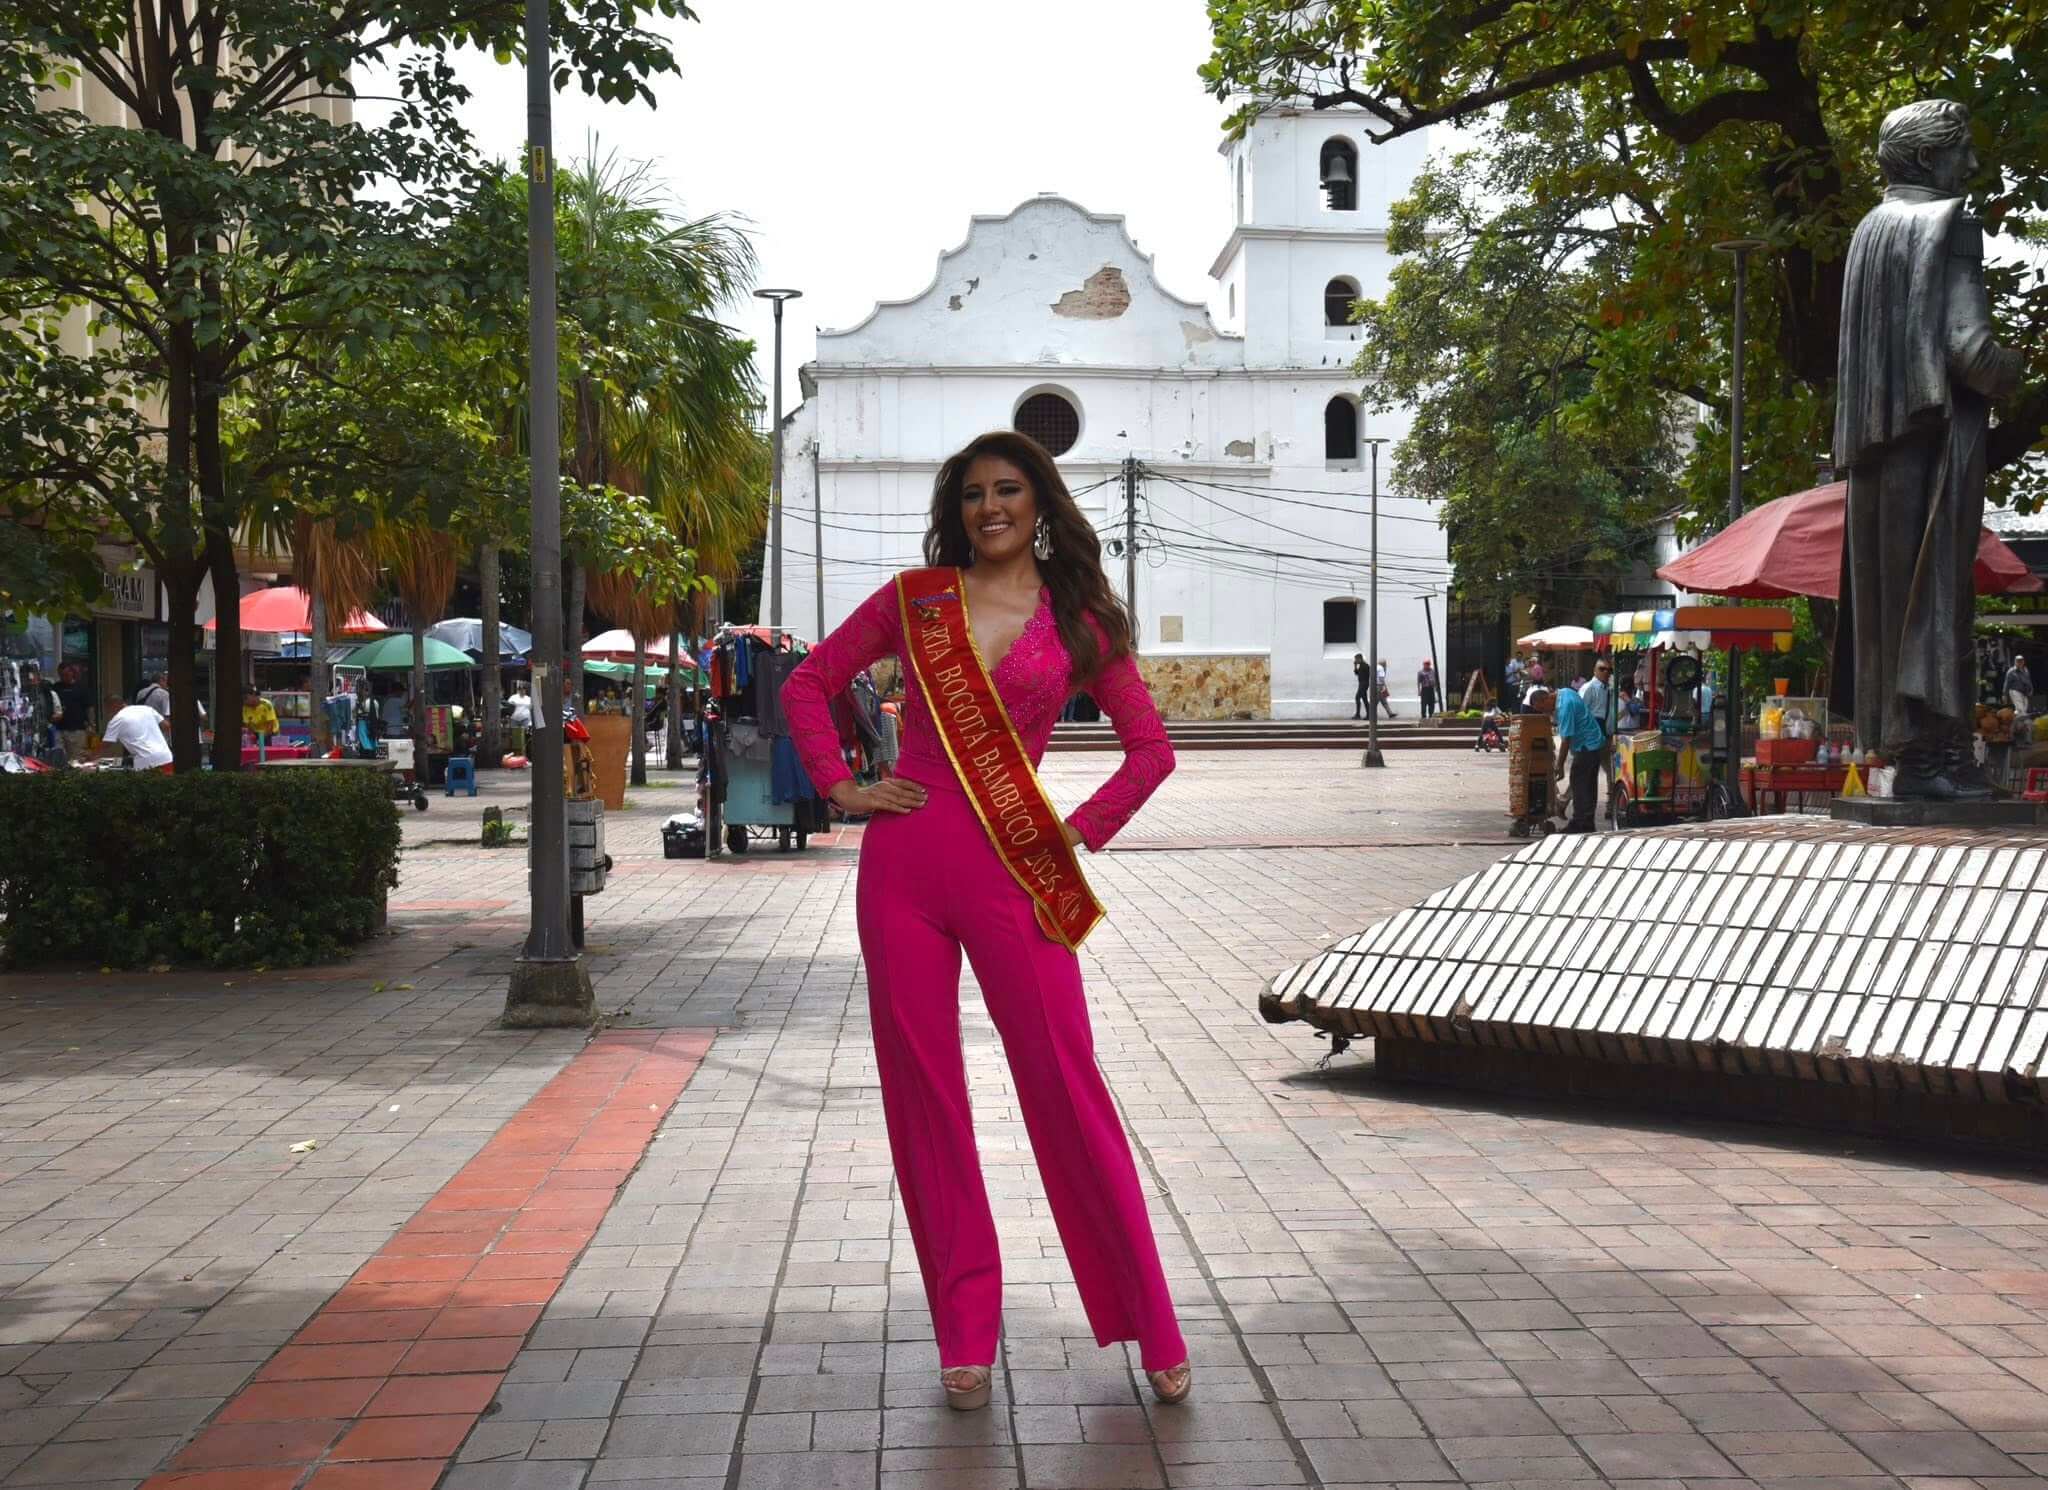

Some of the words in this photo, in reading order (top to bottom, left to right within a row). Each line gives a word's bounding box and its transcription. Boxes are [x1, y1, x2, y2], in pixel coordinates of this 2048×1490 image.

[921, 622, 953, 665] SRTA
[935, 663, 999, 749] BOGOTÁ
[973, 746, 1038, 845] BAMBUCO
[1024, 848, 1063, 893] 2026
